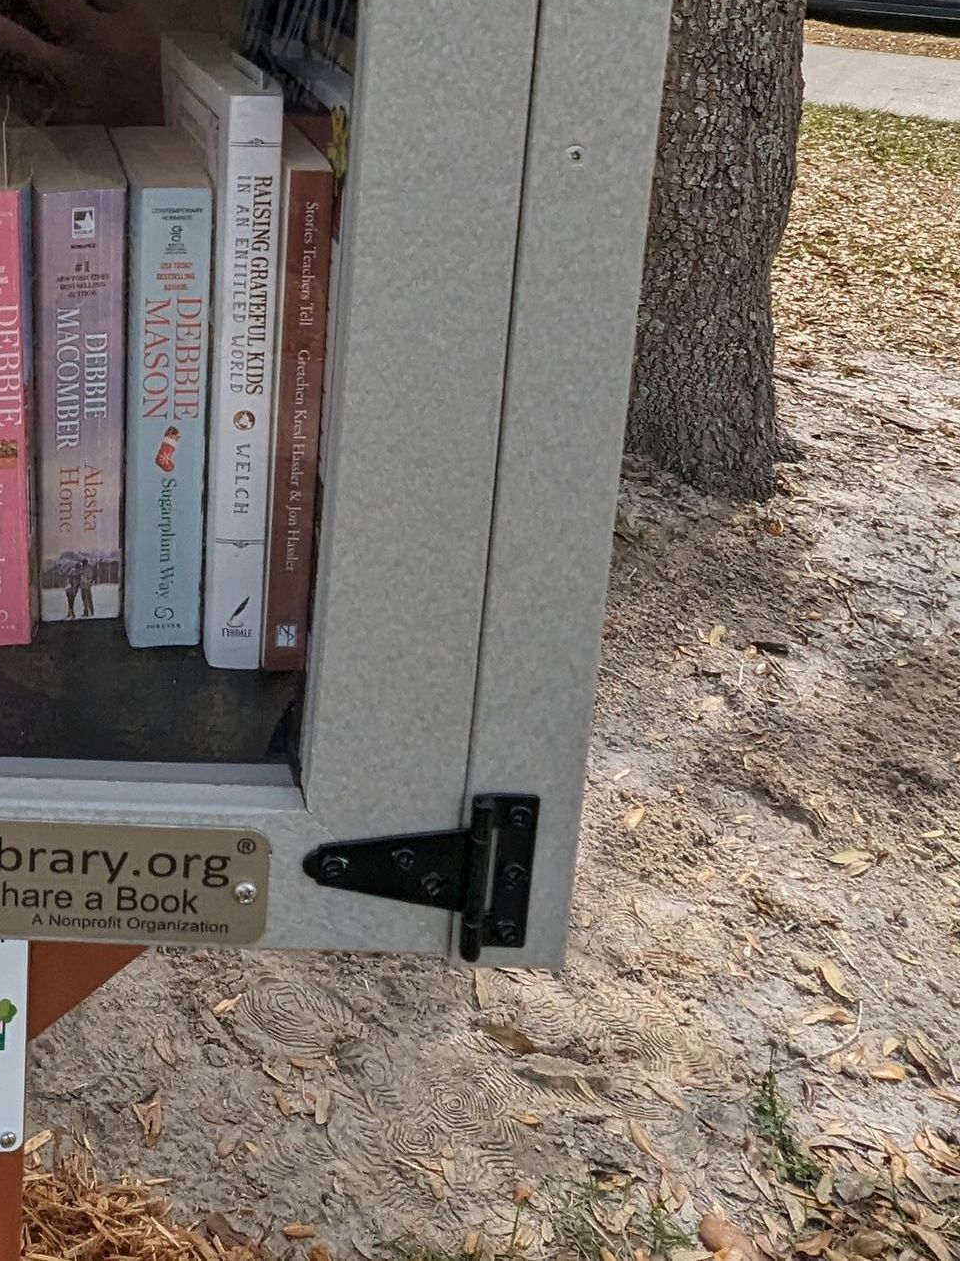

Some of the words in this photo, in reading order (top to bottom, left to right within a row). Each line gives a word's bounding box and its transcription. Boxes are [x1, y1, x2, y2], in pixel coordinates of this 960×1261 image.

[237, 175, 251, 193] IN
[235, 205, 250, 227] AN
[251, 176, 273, 252] RAISING
[303, 201, 320, 244] Stories
[232, 239, 249, 324] ENTITLED
[248, 255, 270, 346] GRATEFUL
[299, 246, 317, 300] Teachers
[298, 302, 314, 326] Tell
[56, 307, 80, 450] MACOMBER
[84, 333, 108, 419] DEBBIE
[143, 298, 172, 420] MASON
[173, 298, 202, 421] DEBBIE
[230, 336, 245, 393] WORLD
[245, 351, 265, 395] KIDS
[294, 349, 311, 405] Gretchen
[233, 443, 250, 514] WELCH
[290, 443, 305, 486] Hassler
[59, 466, 80, 533] Home
[83, 461, 104, 532] Alaska
[157, 477, 177, 563] Sugarplum
[285, 503, 301, 526] Jon
[289, 490, 301, 501] &
[285, 530, 300, 571] Hassler
[155, 566, 175, 598] Way
[31, 914, 43, 926] A
[49, 915, 122, 931] Nonprofit
[126, 916, 229, 934] Organization
[84, 890, 103, 910] a
[116, 887, 198, 915] Book
